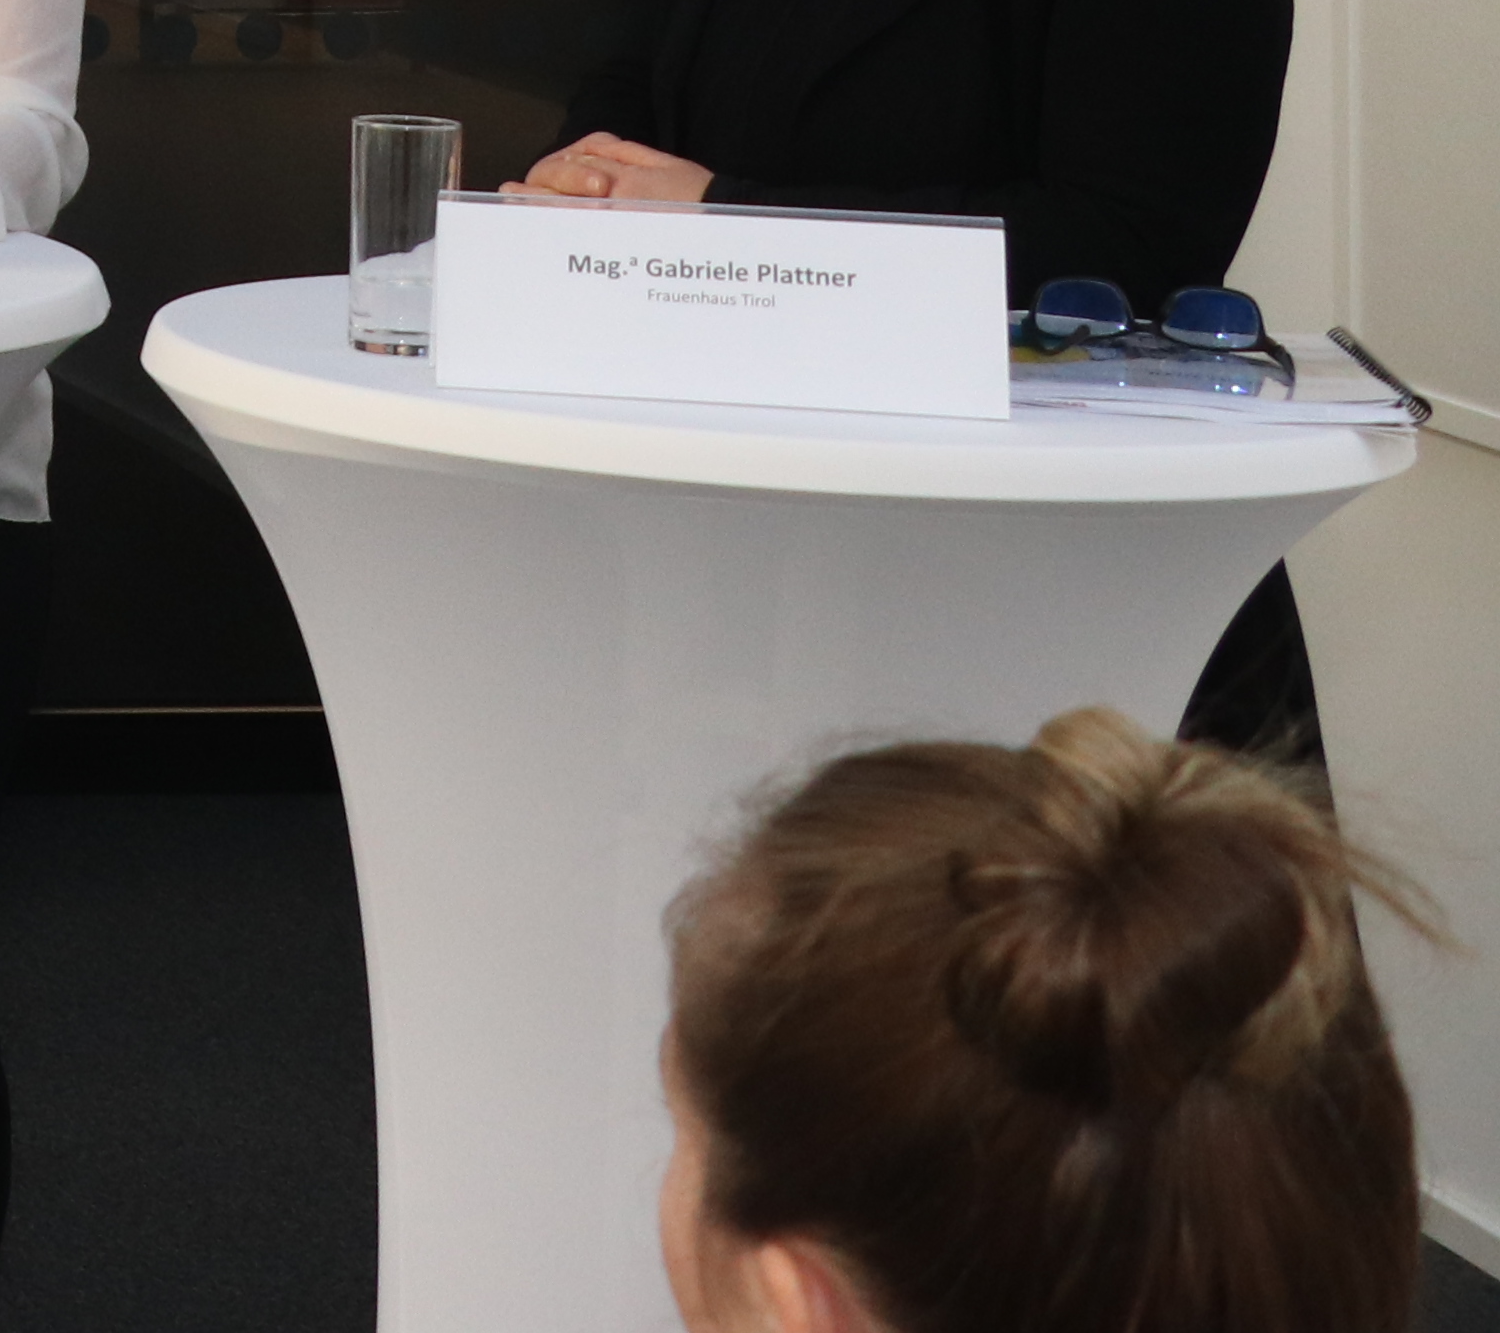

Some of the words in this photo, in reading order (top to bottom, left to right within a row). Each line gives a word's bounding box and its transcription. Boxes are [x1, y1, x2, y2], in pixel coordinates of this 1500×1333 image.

[645, 258, 750, 283] Gabriele
[757, 262, 857, 288] Plattner
[647, 288, 737, 306] Frauenhaus
[742, 293, 776, 308] Tirol
